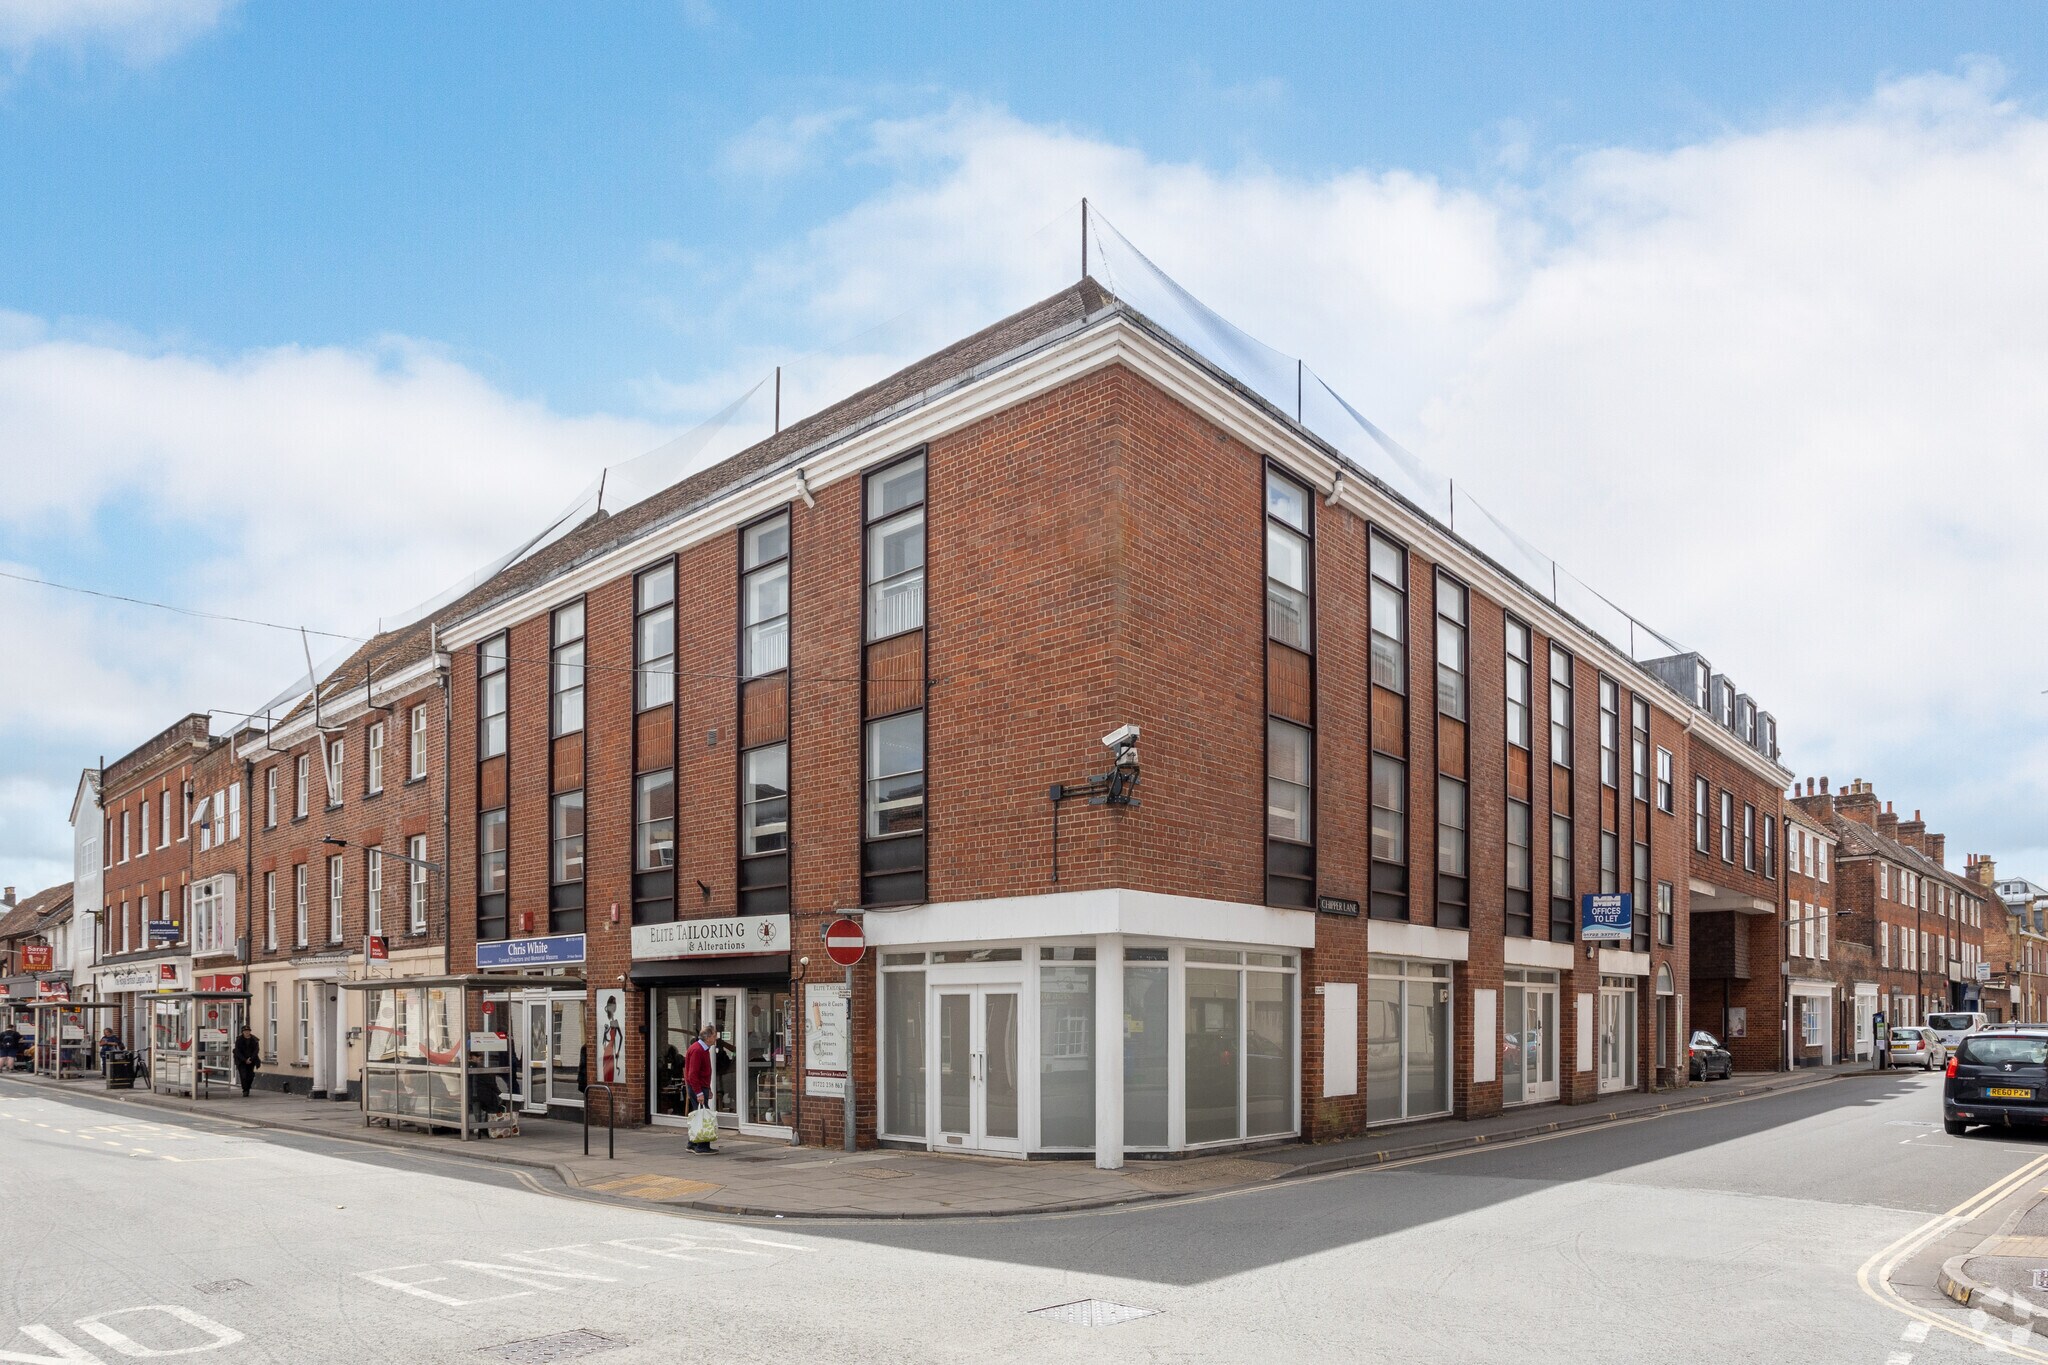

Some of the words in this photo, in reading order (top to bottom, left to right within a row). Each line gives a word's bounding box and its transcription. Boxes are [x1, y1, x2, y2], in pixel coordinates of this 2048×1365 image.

[1321, 900, 1343, 911] CHIPPER
[1343, 902, 1357, 912] LANE
[1591, 907, 1621, 915] OFFICES
[650, 927, 674, 943] ELITE
[676, 922, 745, 941] TAILORING
[507, 943, 526, 956] Chris
[527, 941, 549, 954] White
[688, 941, 695, 951] &
[697, 940, 746, 951] Alterations
[2013, 1089, 2030, 1097] PZW
[352, 1228, 820, 1307] ENTRY
